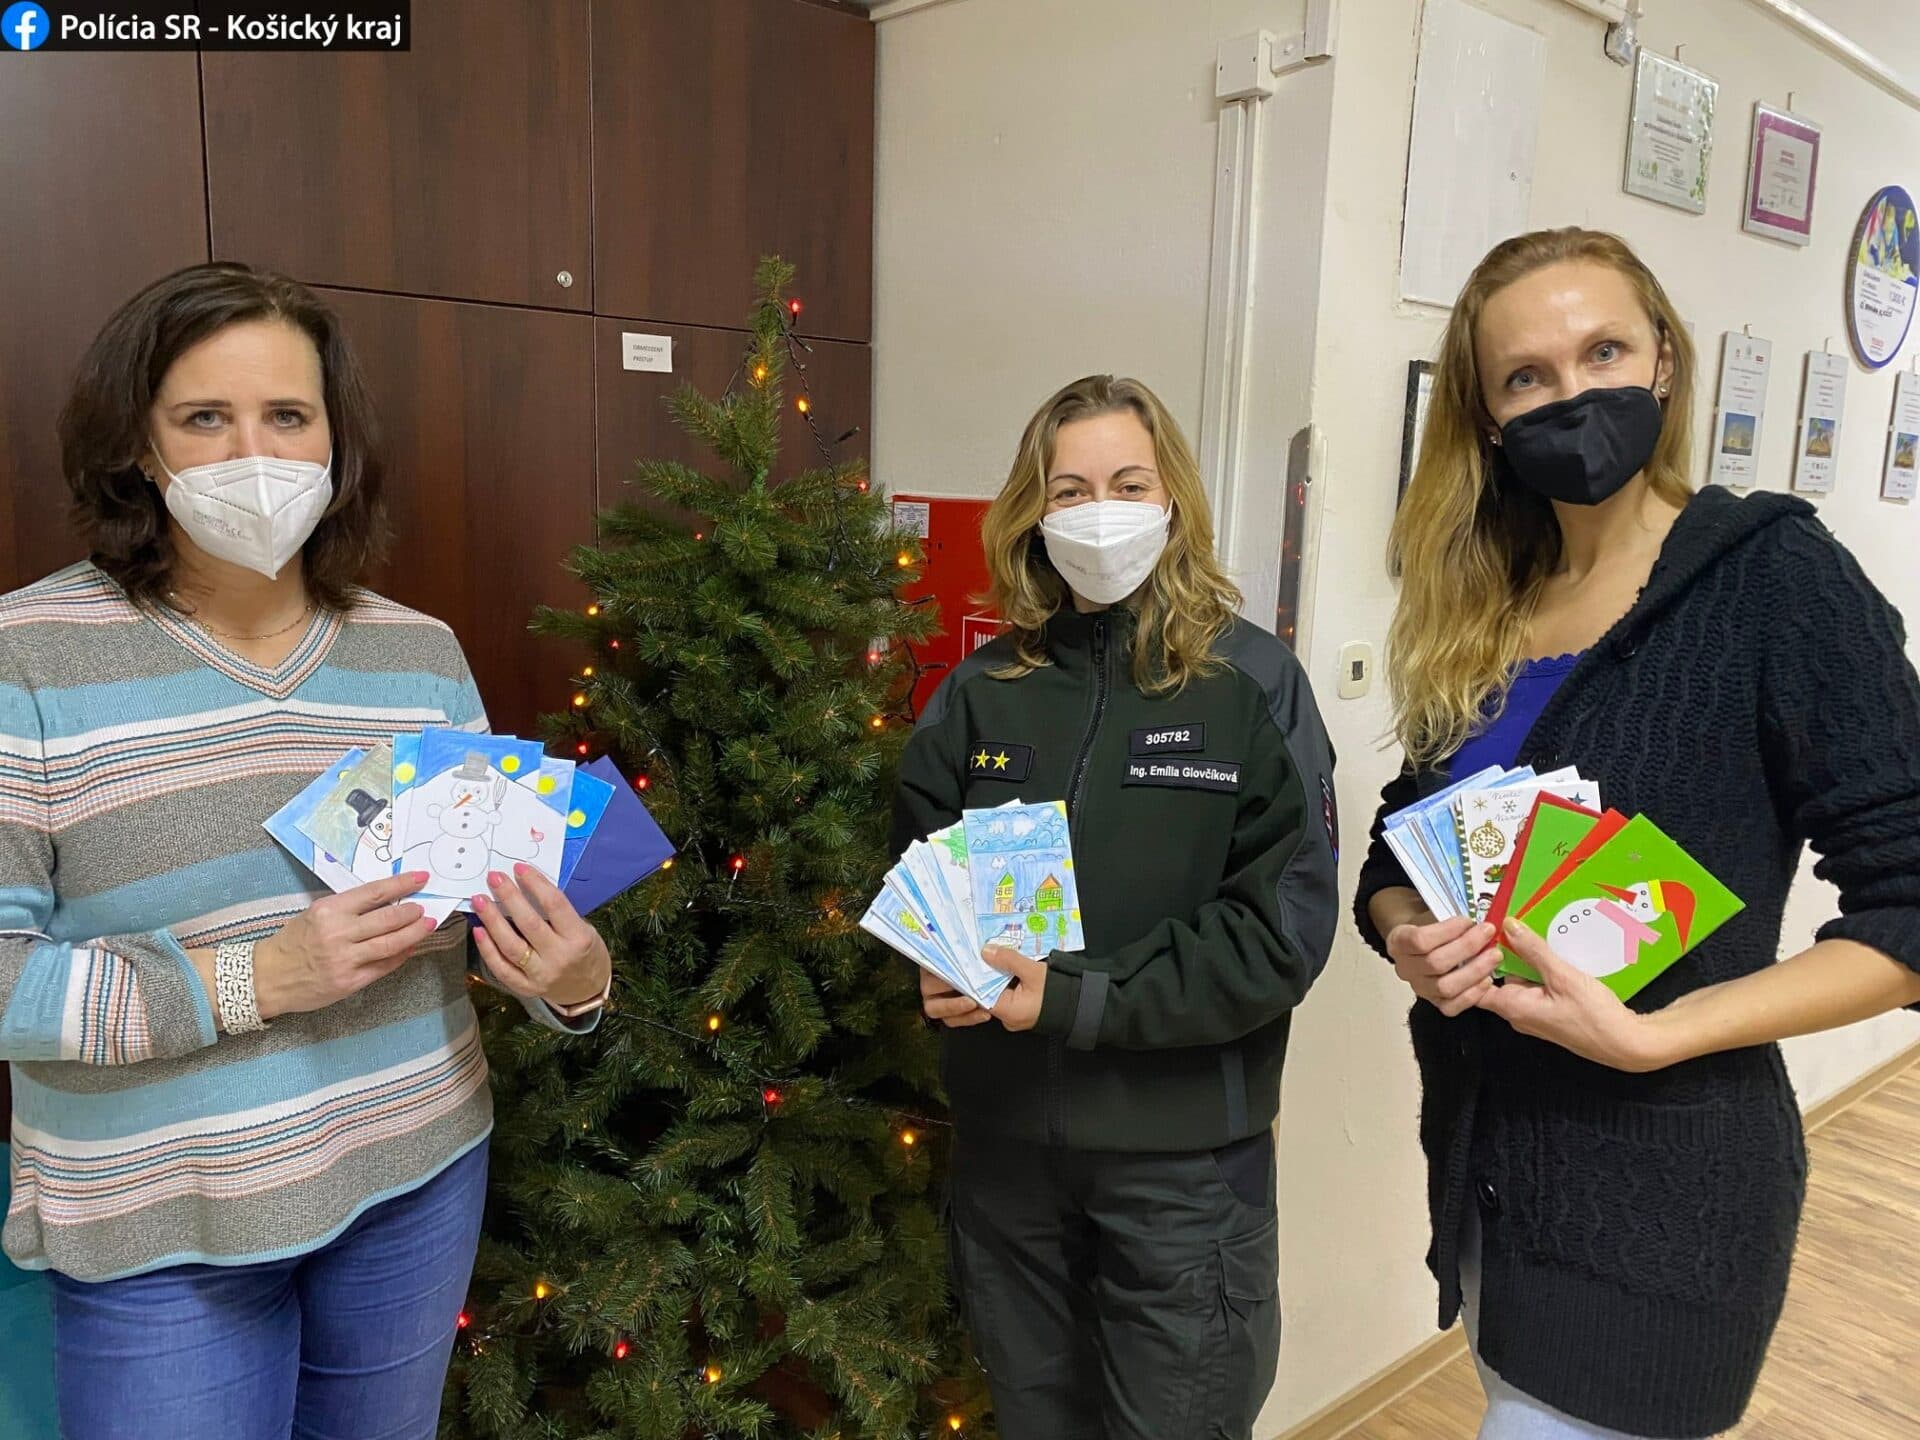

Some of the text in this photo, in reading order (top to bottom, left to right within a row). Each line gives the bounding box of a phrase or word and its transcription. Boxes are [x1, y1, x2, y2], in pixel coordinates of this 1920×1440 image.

[1145, 730, 1191, 745] 305782
[1129, 765, 1238, 783] Ing. Emília Glovčíková
